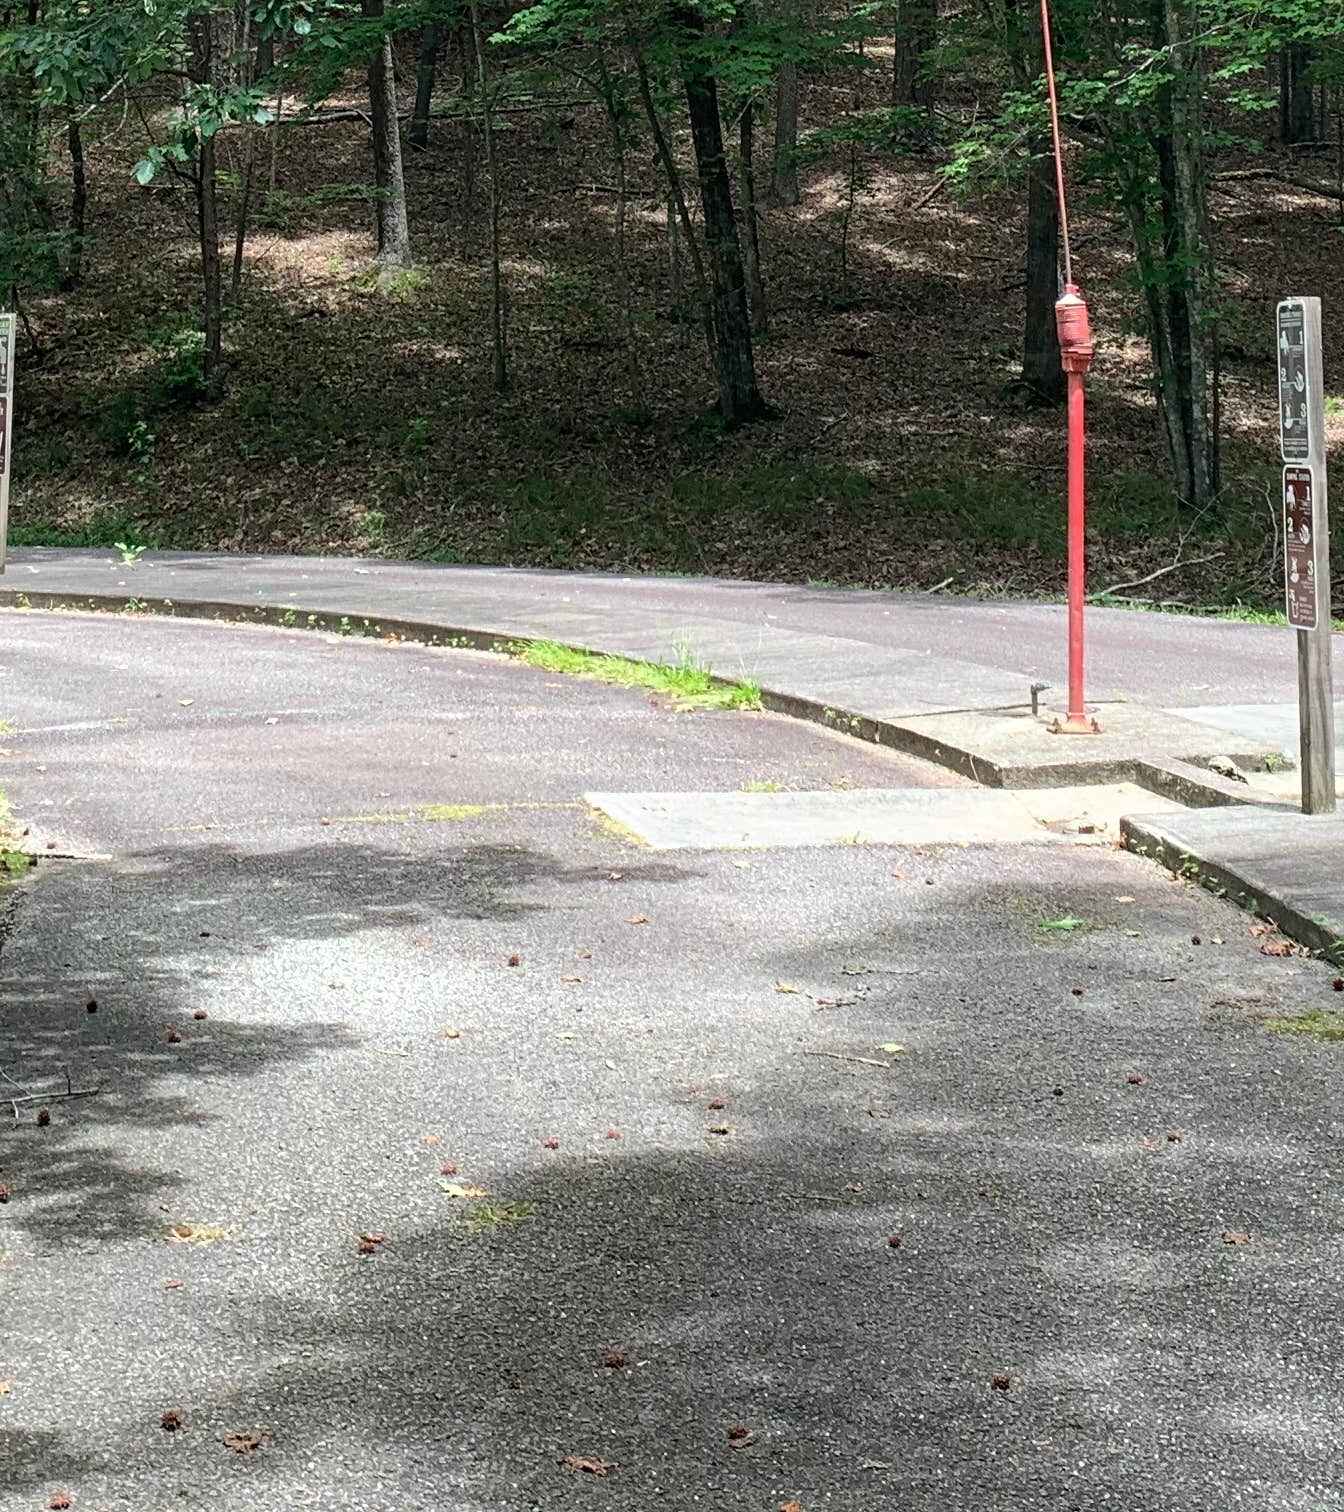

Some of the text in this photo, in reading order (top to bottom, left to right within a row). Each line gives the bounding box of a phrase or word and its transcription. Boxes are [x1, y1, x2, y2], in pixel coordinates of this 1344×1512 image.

[1299, 330, 1304, 345] 1
[1280, 367, 1287, 382] 2
[1300, 402, 1307, 418] 3
[1306, 486, 1311, 501] 1
[1287, 517, 1294, 533] 2
[1307, 559, 1314, 575] 3
